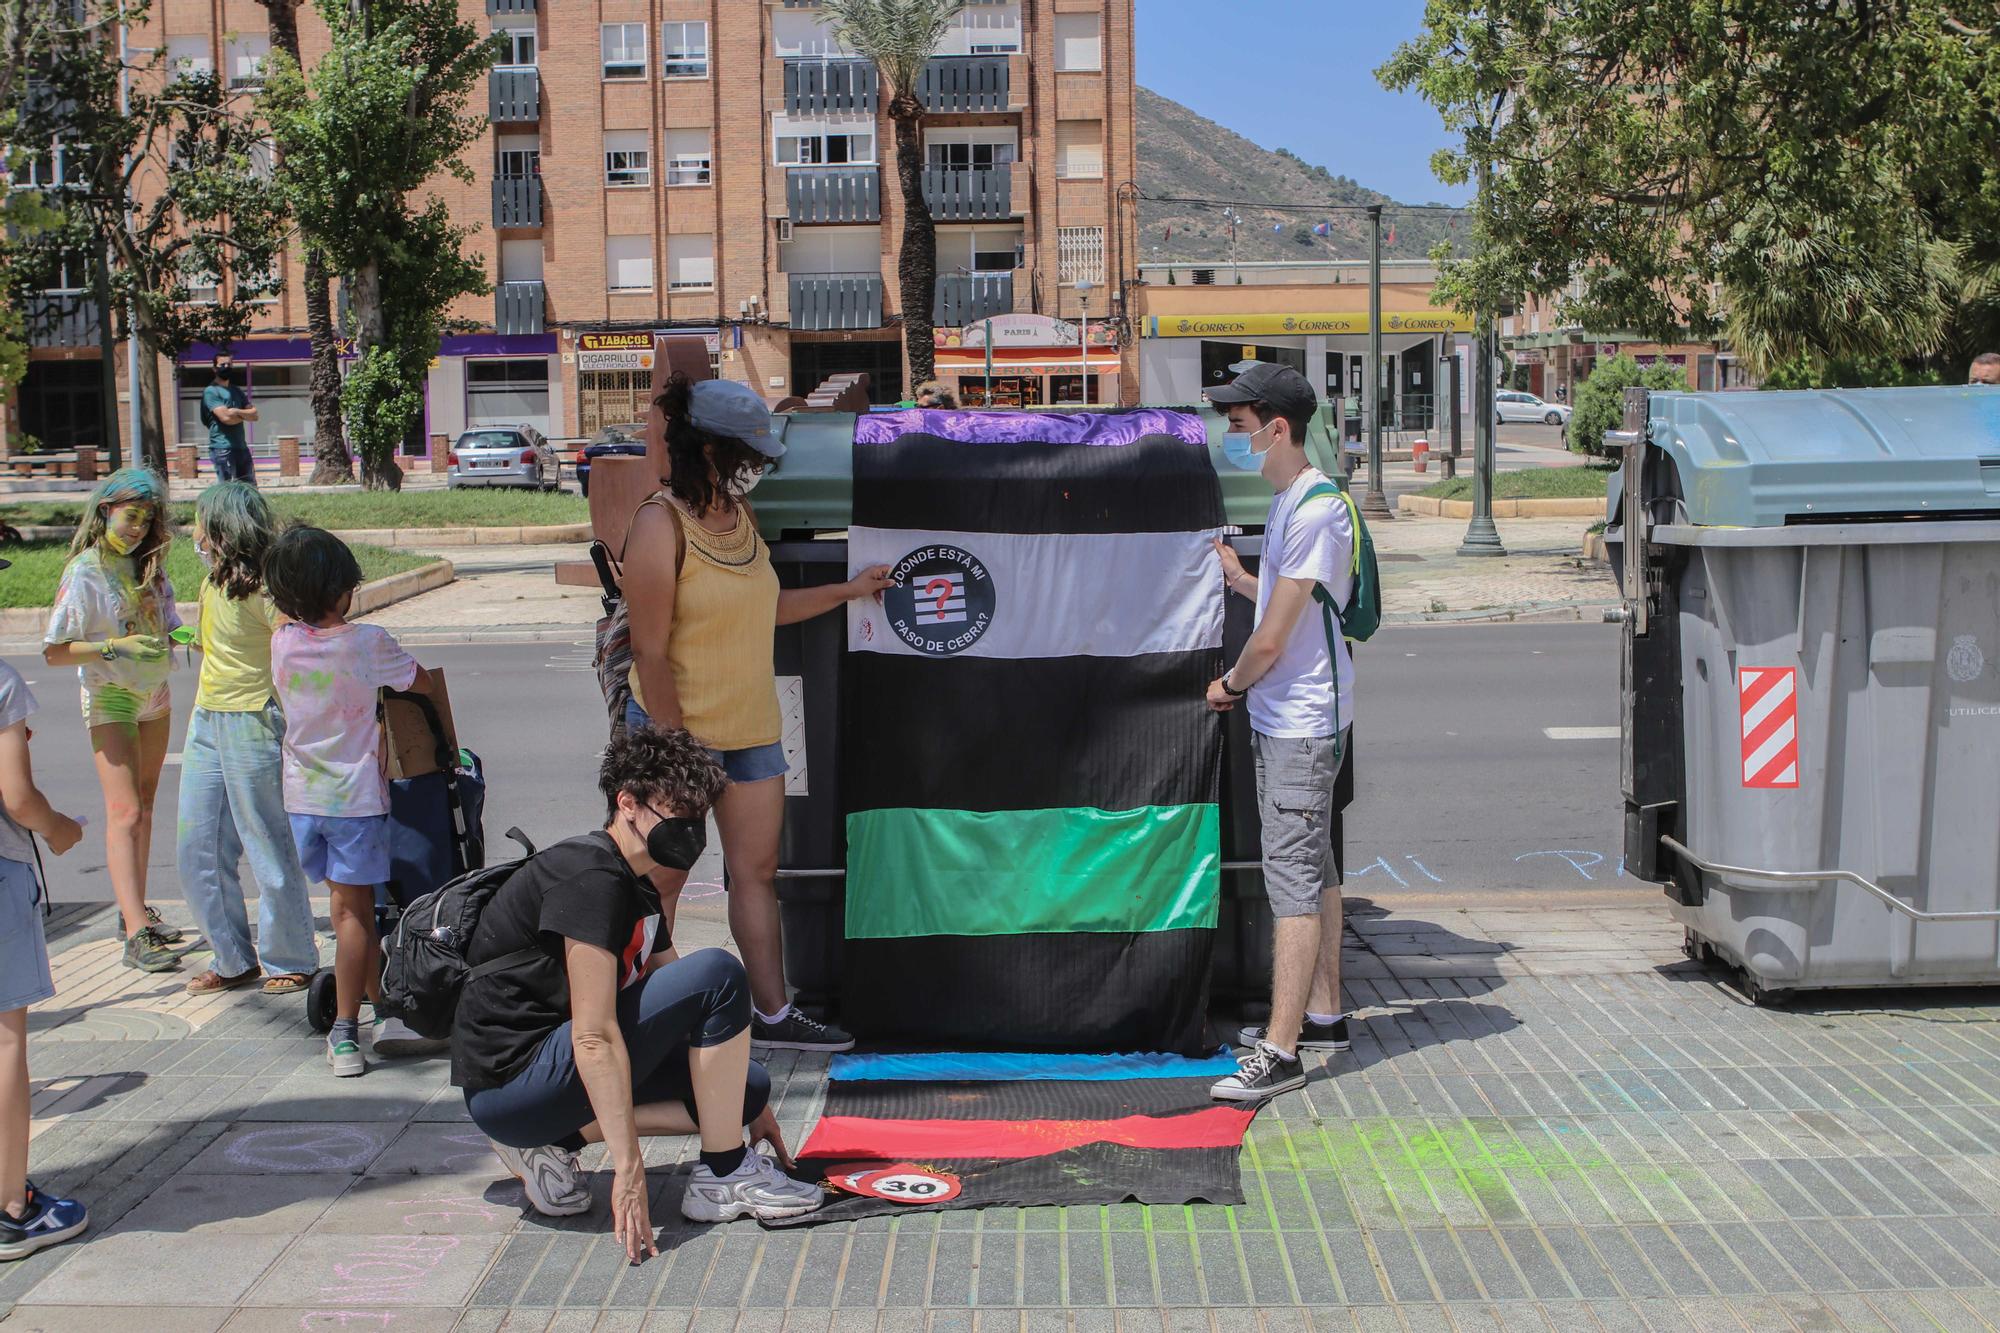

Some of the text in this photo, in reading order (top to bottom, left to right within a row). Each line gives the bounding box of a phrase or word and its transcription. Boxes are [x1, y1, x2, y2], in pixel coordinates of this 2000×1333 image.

[1193, 322, 1245, 333] CORREOS
[1299, 320, 1350, 331] CORREOS
[1404, 319, 1455, 329] CORREOS
[599, 335, 649, 346] TABACOS
[582, 354, 638, 363] CIGARRILLO
[1044, 365, 1099, 374] PARS
[939, 549, 972, 568] ESTÁ
[970, 564, 986, 581] MI
[894, 612, 989, 652] PASO DE CEBRA?
[882, 1181, 936, 1194] 30
